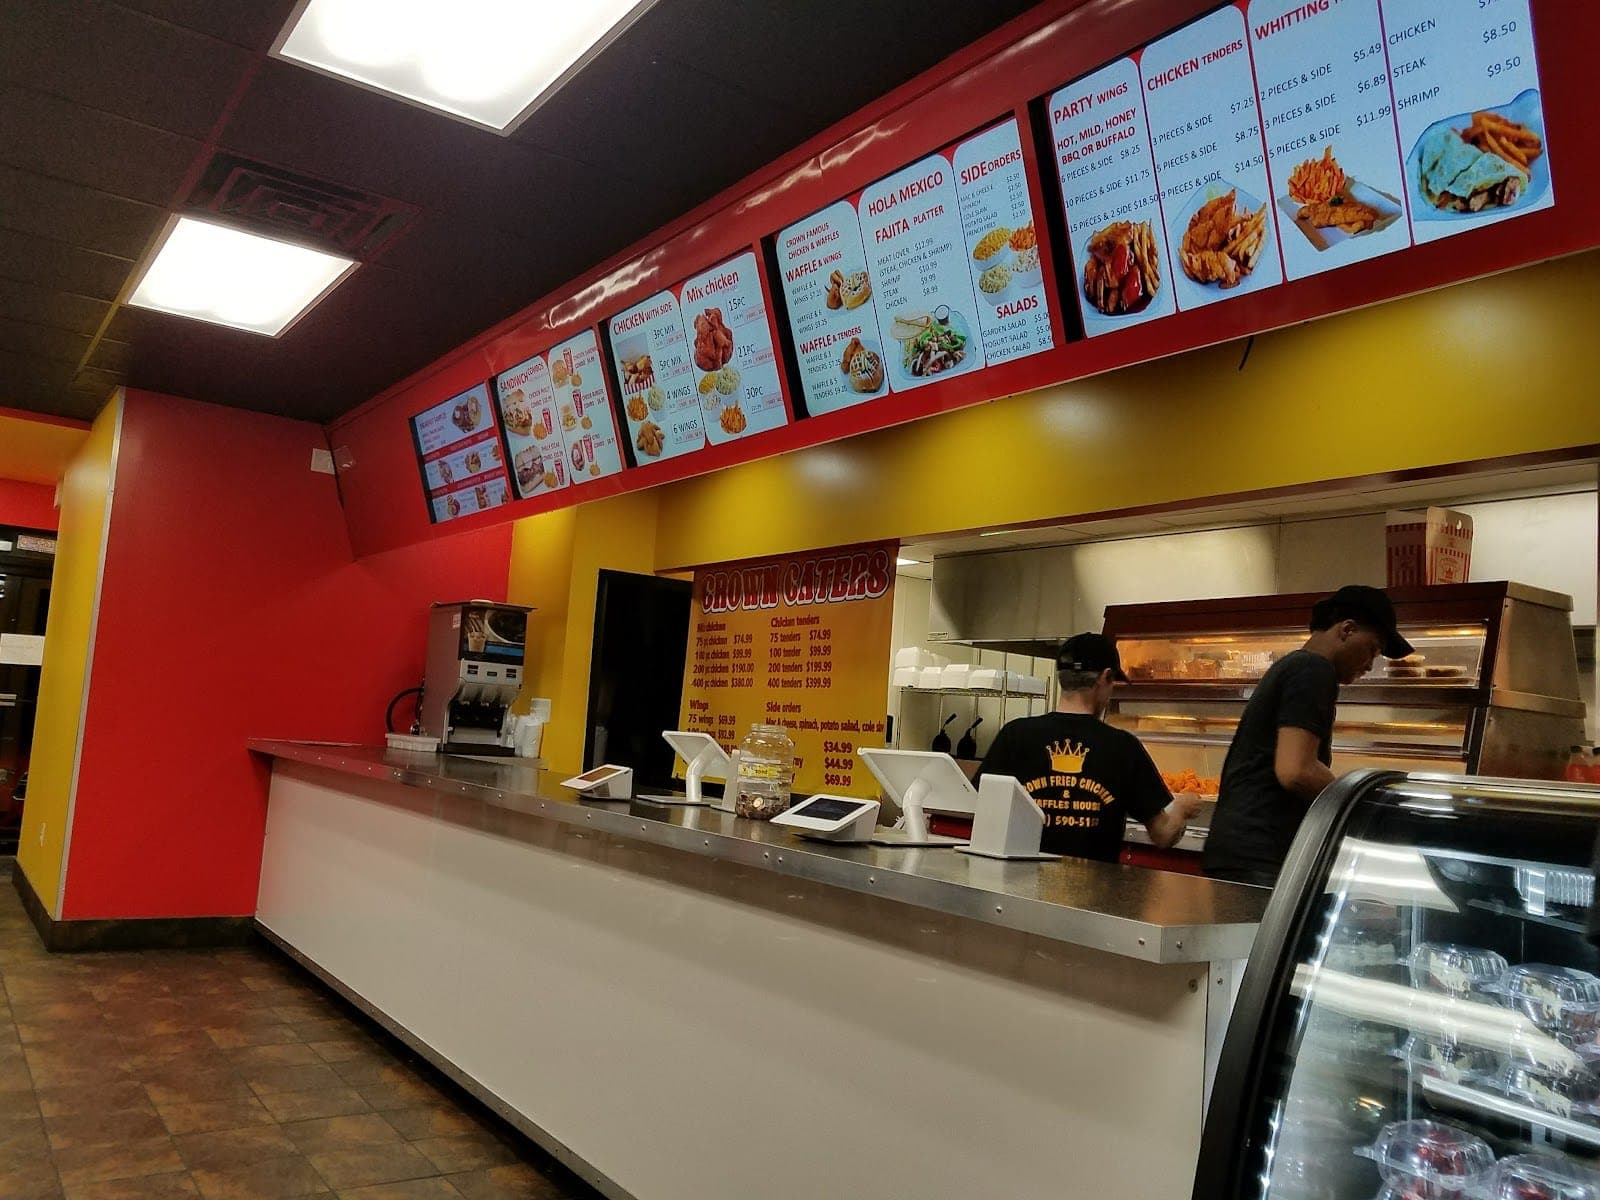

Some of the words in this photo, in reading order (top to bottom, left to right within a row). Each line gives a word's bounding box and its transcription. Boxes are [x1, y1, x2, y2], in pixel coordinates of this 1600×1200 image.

[1255, 0, 1329, 40] WHITTING
[1389, 18, 1436, 45] CHICKEN
[1483, 21, 1516, 44] $8.50
[1147, 57, 1199, 91] CHICKEN
[1201, 39, 1242, 65] TENDERS
[1261, 92, 1265, 100] 2
[1268, 77, 1298, 97] PIECES
[1300, 74, 1308, 84] &
[1310, 63, 1333, 80] SIDE
[1353, 43, 1381, 62] $5.49
[1393, 57, 1427, 78] STEAK
[1487, 56, 1521, 78] $9.50
[1054, 94, 1093, 124] PARTY
[1097, 82, 1128, 104] WINGS
[1265, 120, 1270, 129] 3
[1272, 108, 1302, 126] PIECES
[1305, 104, 1312, 113] &
[1315, 94, 1337, 110] SIDE
[1357, 74, 1386, 94] $6.89
[1398, 86, 1440, 110] SHRIMP
[1057, 135, 1078, 150] HOT,
[1079, 124, 1103, 141] MILD,
[1105, 108, 1136, 130] HONEY
[1153, 138, 1157, 146] 3
[1159, 126, 1185, 144] PIECES
[1186, 124, 1192, 132] &
[1195, 114, 1213, 128] SIDE
[1230, 96, 1254, 114] $7.25
[1269, 150, 1275, 158] 5
[1276, 137, 1307, 156] PIECES
[1309, 134, 1316, 143] &
[1319, 124, 1341, 139] SIDE
[1356, 106, 1391, 127] $11.99
[1062, 151, 1080, 165] BBQ
[1082, 144, 1094, 156] OR
[1096, 126, 1135, 150] BUFFALO
[1157, 165, 1161, 173] 5
[1163, 154, 1189, 173] PIECES
[1191, 151, 1197, 159] &
[1199, 142, 1217, 157] SIDE
[1235, 126, 1259, 143] $8.75
[961, 161, 987, 185] SIDE
[988, 149, 1020, 171] ORDERS
[1067, 164, 1089, 182] PIECES
[1098, 156, 1113, 169] SIDE
[1120, 145, 1140, 160] $8.25
[1161, 191, 1166, 199] 9
[1167, 181, 1193, 199] PIECES
[1196, 178, 1201, 186] &
[1203, 171, 1222, 185] SIDE
[1235, 155, 1264, 173] $14.50
[869, 193, 897, 217] HOLA
[900, 172, 943, 202] MEXICO
[1066, 200, 1074, 209] 10
[1075, 190, 1097, 206] PIECES
[1106, 180, 1122, 193] SIDE
[1125, 169, 1150, 186] $11.75
[1070, 224, 1077, 233] 15
[1078, 215, 1101, 231] PIECES
[1117, 203, 1132, 216] SIDE
[1134, 194, 1158, 210] $18.50
[875, 218, 910, 244] FAJITA
[913, 205, 944, 225] PLATTER
[785, 234, 805, 248] CROWN
[806, 222, 829, 240] FAMOUS
[788, 245, 809, 259] CHICKEN
[816, 231, 839, 247] WAFFLES
[785, 260, 818, 282] WAFFLE
[818, 259, 822, 267] &
[823, 251, 842, 264] WINGS
[878, 255, 892, 266] MEAT
[899, 255, 922, 270] CHICKEN
[686, 288, 704, 303] Mix
[706, 271, 739, 296] chicken
[881, 274, 901, 288] SHRIMP
[883, 287, 898, 298] STEAK
[921, 273, 936, 285] $9.99
[729, 297, 745, 311] 15PC
[886, 296, 907, 310] CHICKEN
[997, 295, 1038, 318] SALADS
[614, 311, 645, 335] CHICKEN
[645, 308, 659, 320] WITH
[660, 302, 672, 314] SIDE
[654, 329, 664, 339] 3PC
[983, 325, 1006, 337] GARDEN
[1008, 319, 1026, 330] SALAD
[800, 335, 832, 355] WAFFLE
[838, 326, 861, 341] TENDERS
[985, 337, 1007, 348] YOGURT
[1009, 331, 1027, 341] SALAD
[738, 344, 755, 357] 21PC
[987, 347, 1010, 359] CHICKEN
[1012, 342, 1030, 352] SALAD
[808, 362, 827, 374] TENDERS
[501, 372, 528, 392] SANDWICH
[667, 391, 670, 400] 4
[672, 386, 691, 398] WINGS
[746, 386, 763, 399] 30PC
[674, 425, 677, 434] 6
[679, 420, 698, 432] WINGS
[701, 564, 780, 615] CROWN
[784, 550, 890, 606] CATERS
[771, 617, 795, 627] Chicken
[797, 613, 819, 625] tenders
[734, 634, 752, 644] $74.99
[771, 633, 778, 642] 75
[780, 631, 801, 642] tenders
[810, 629, 831, 640] $74.99
[733, 648, 751, 659] $99.99
[770, 648, 781, 657] 100
[810, 645, 831, 656] $99.99
[693, 664, 704, 673] 200
[768, 663, 780, 672] 200
[782, 662, 803, 672] tenders
[807, 661, 832, 672] $199.99
[692, 678, 704, 687] 400
[768, 678, 779, 688] 400
[782, 677, 802, 688] tenders
[806, 677, 831, 688] $399.99
[690, 700, 708, 712] Wings
[766, 701, 780, 712] Side
[782, 703, 801, 713] orders
[688, 714, 697, 722] 75
[699, 715, 713, 726] wings
[719, 715, 735, 725] $69.99
[799, 718, 819, 731] spinach,
[820, 721, 839, 732] potato
[841, 720, 860, 733] salad,
[862, 721, 874, 732] cole
[718, 729, 734, 739] $92.99
[824, 741, 852, 753] $34.99
[825, 757, 853, 770] $44.99
[825, 774, 851, 786] $69.99
[1050, 776, 1077, 787] FRIED
[1080, 778, 1115, 805] CHICKEN
[1063, 790, 1070, 798] &
[1034, 799, 1069, 809] AFFLES
[1055, 816, 1100, 827] 590-51
